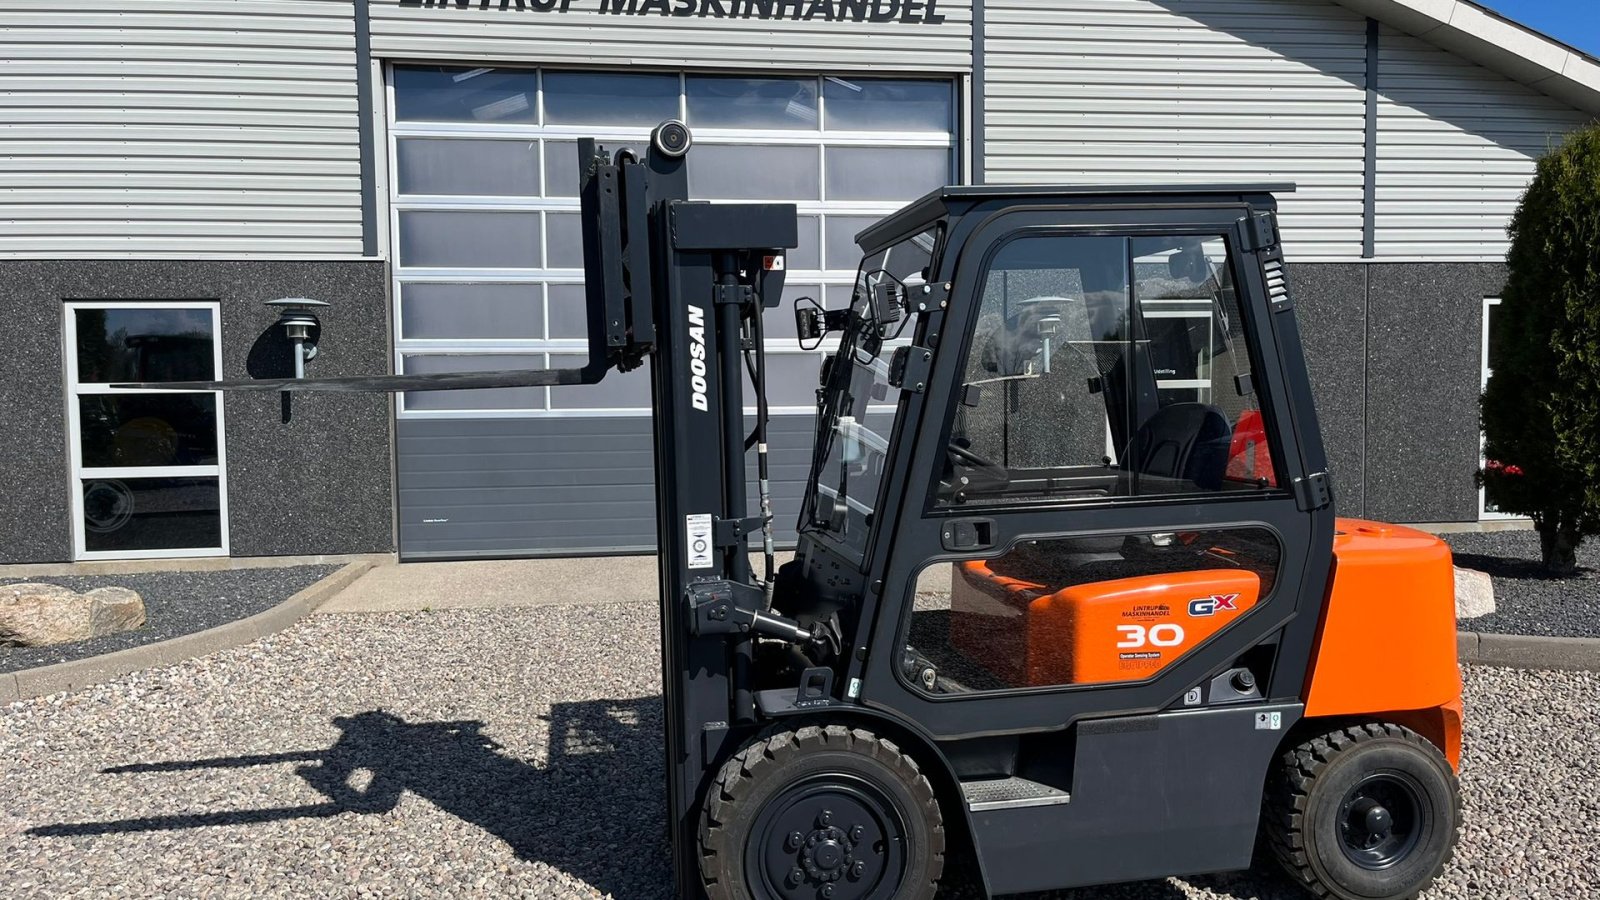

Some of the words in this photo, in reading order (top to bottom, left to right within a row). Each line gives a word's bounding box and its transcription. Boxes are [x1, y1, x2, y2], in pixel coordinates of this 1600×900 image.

[688, 304, 708, 412] DOOSAN
[1188, 593, 1240, 617] GX
[1116, 623, 1185, 648] 30
